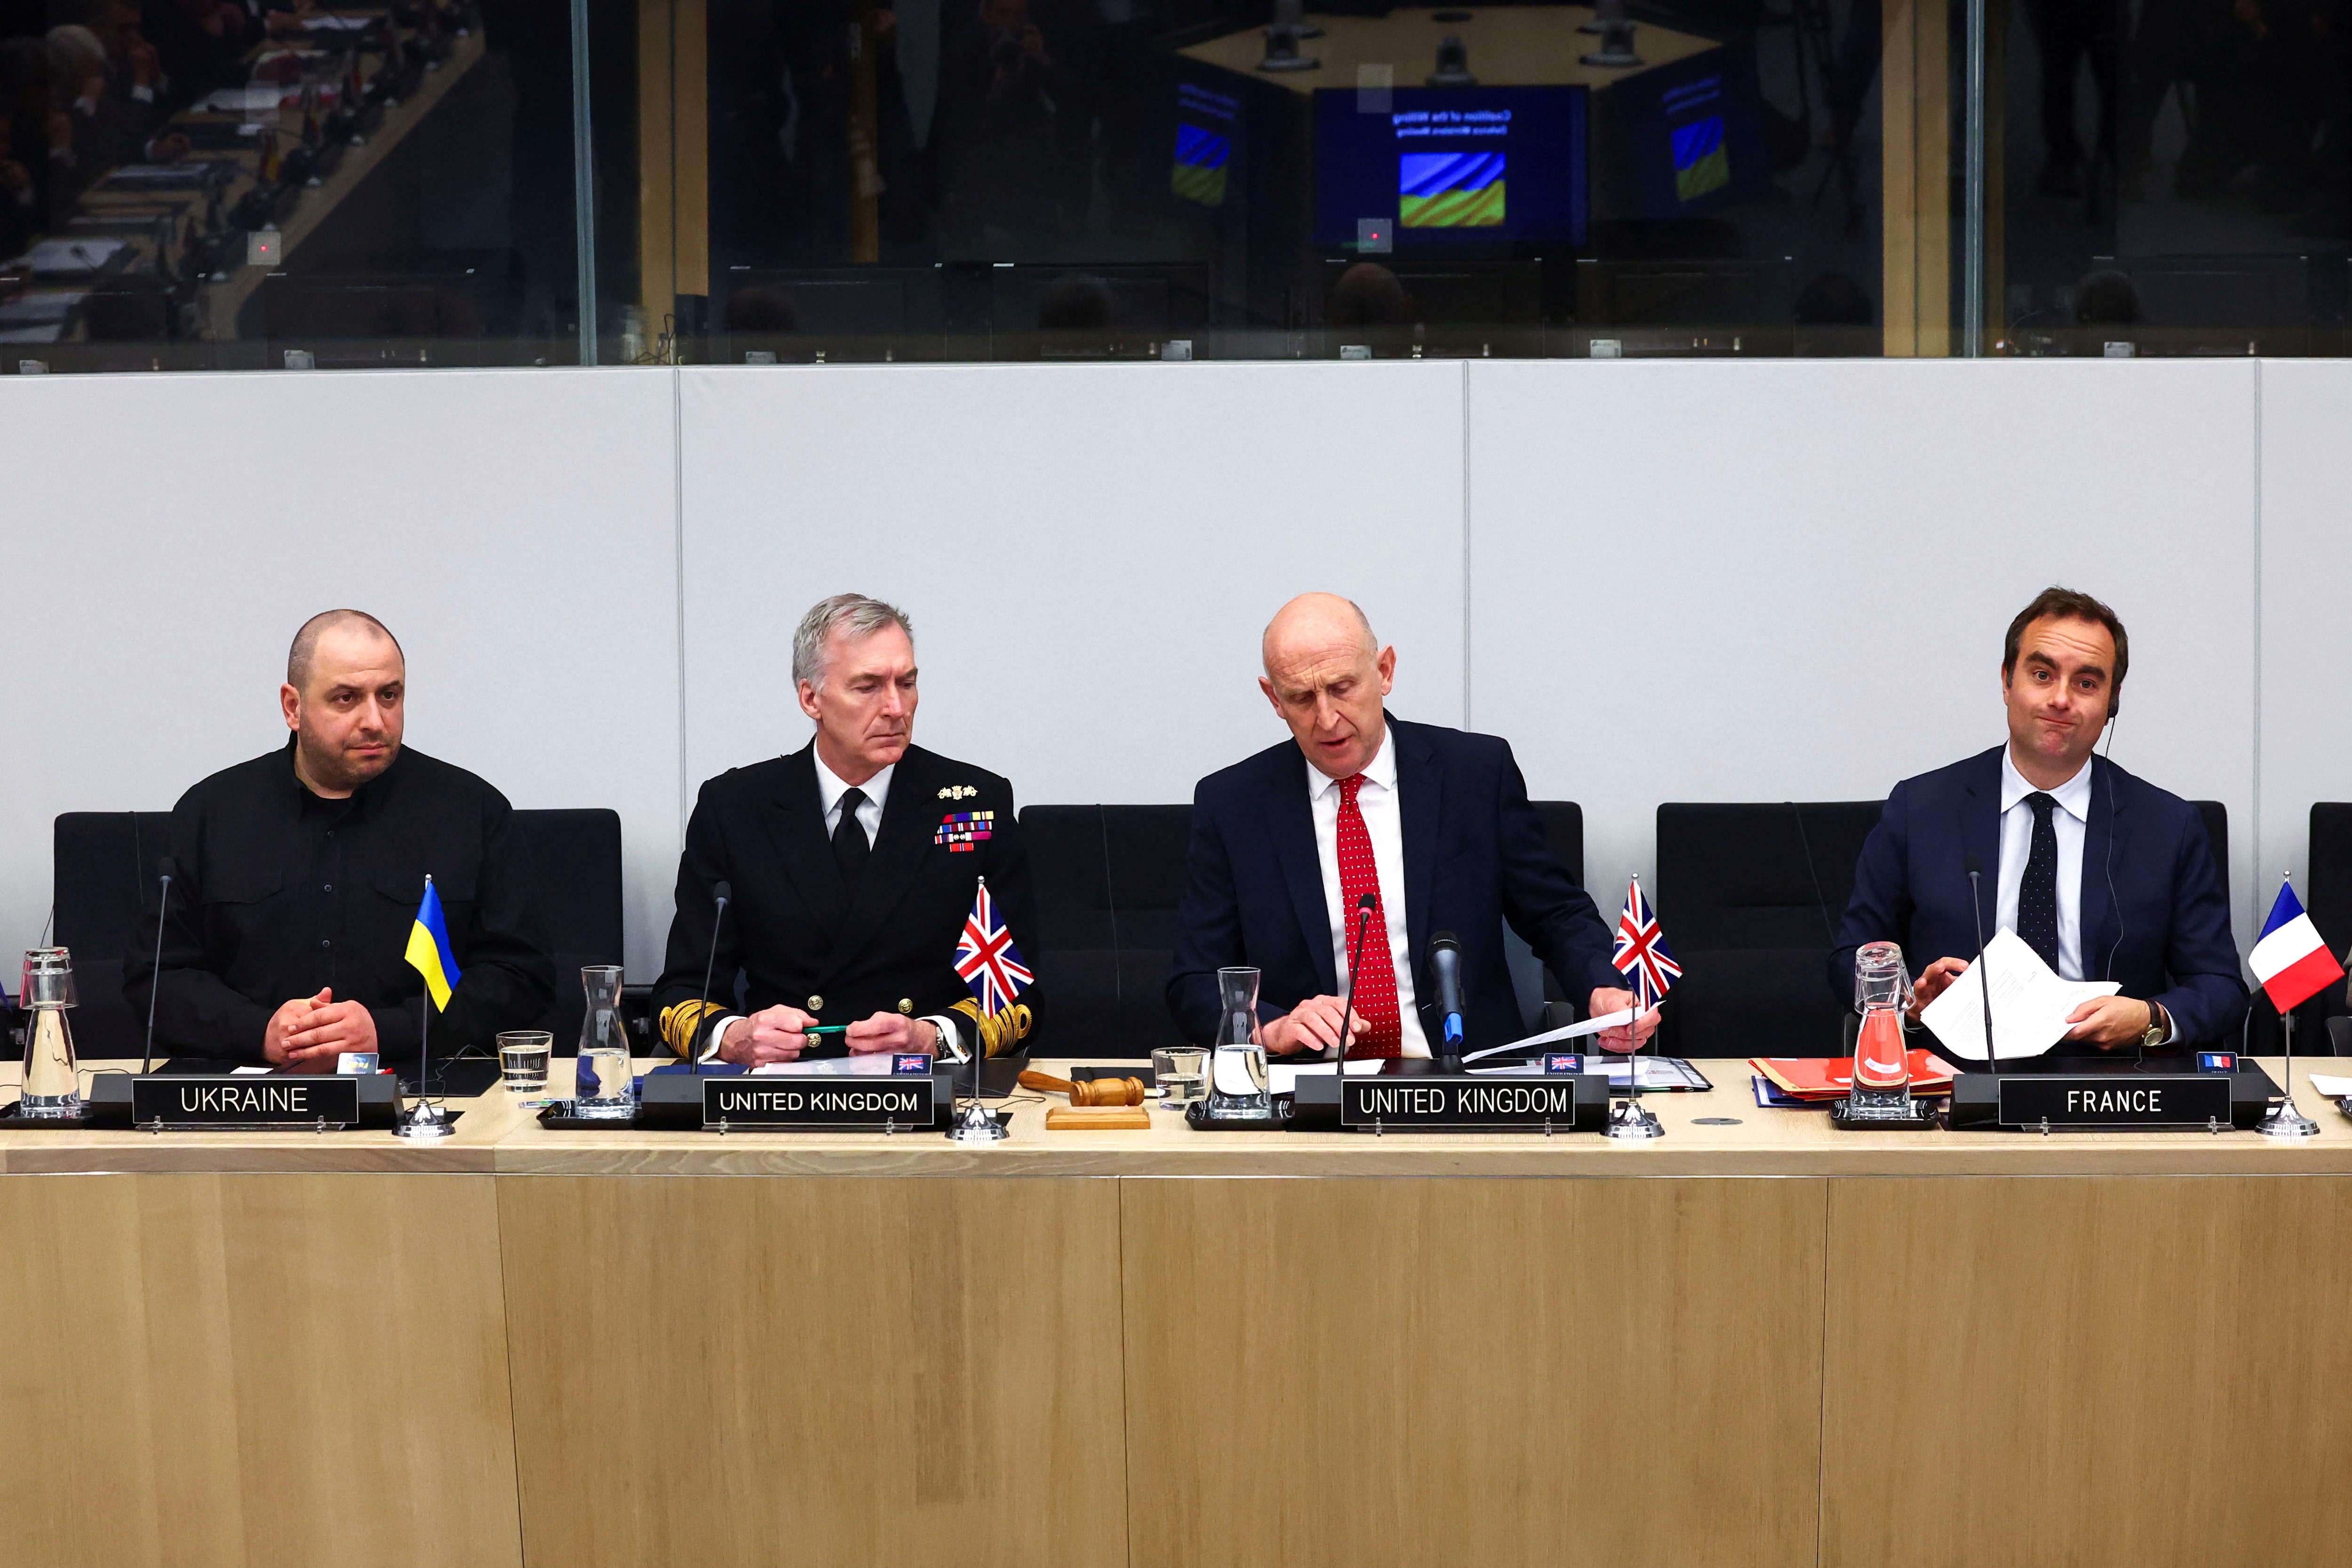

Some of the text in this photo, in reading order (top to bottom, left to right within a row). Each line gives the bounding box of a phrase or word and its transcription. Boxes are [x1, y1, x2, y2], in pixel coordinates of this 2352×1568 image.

[181, 1087, 308, 1112] UKRAINE
[720, 1092, 917, 1111] UNITED KINGDOM
[1360, 1088, 1566, 1114] UNITED KINGDOM
[2067, 1090, 2161, 1112] FRANCE
